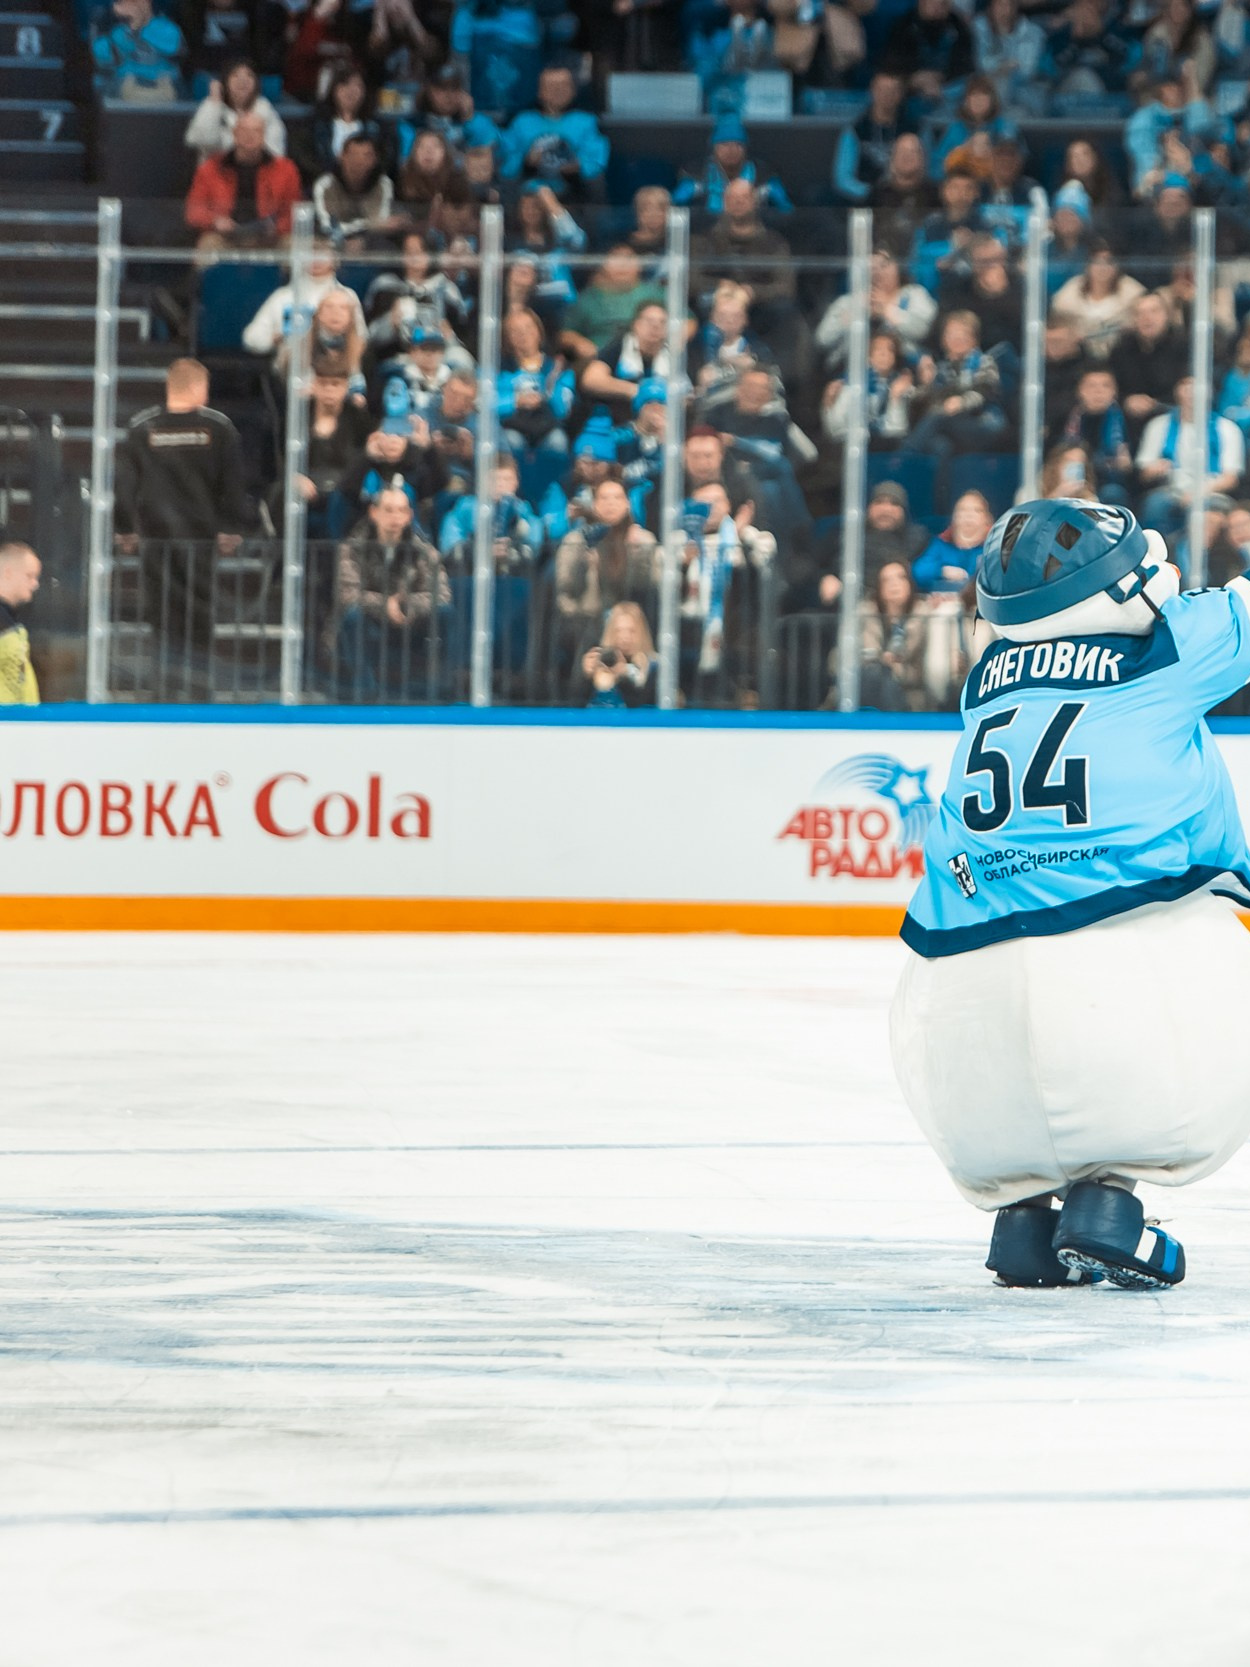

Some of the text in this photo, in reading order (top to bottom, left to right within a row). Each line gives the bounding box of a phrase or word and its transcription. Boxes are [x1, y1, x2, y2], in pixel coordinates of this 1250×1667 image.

[978, 641, 1124, 698] СНЕГОВИК
[962, 701, 1091, 833] 54
[0, 771, 432, 839] ЛОВКА Cola
[777, 807, 890, 840] АВТО
[808, 842, 925, 879] РАДИ
[984, 860, 1038, 881] ОБЛАСТ
